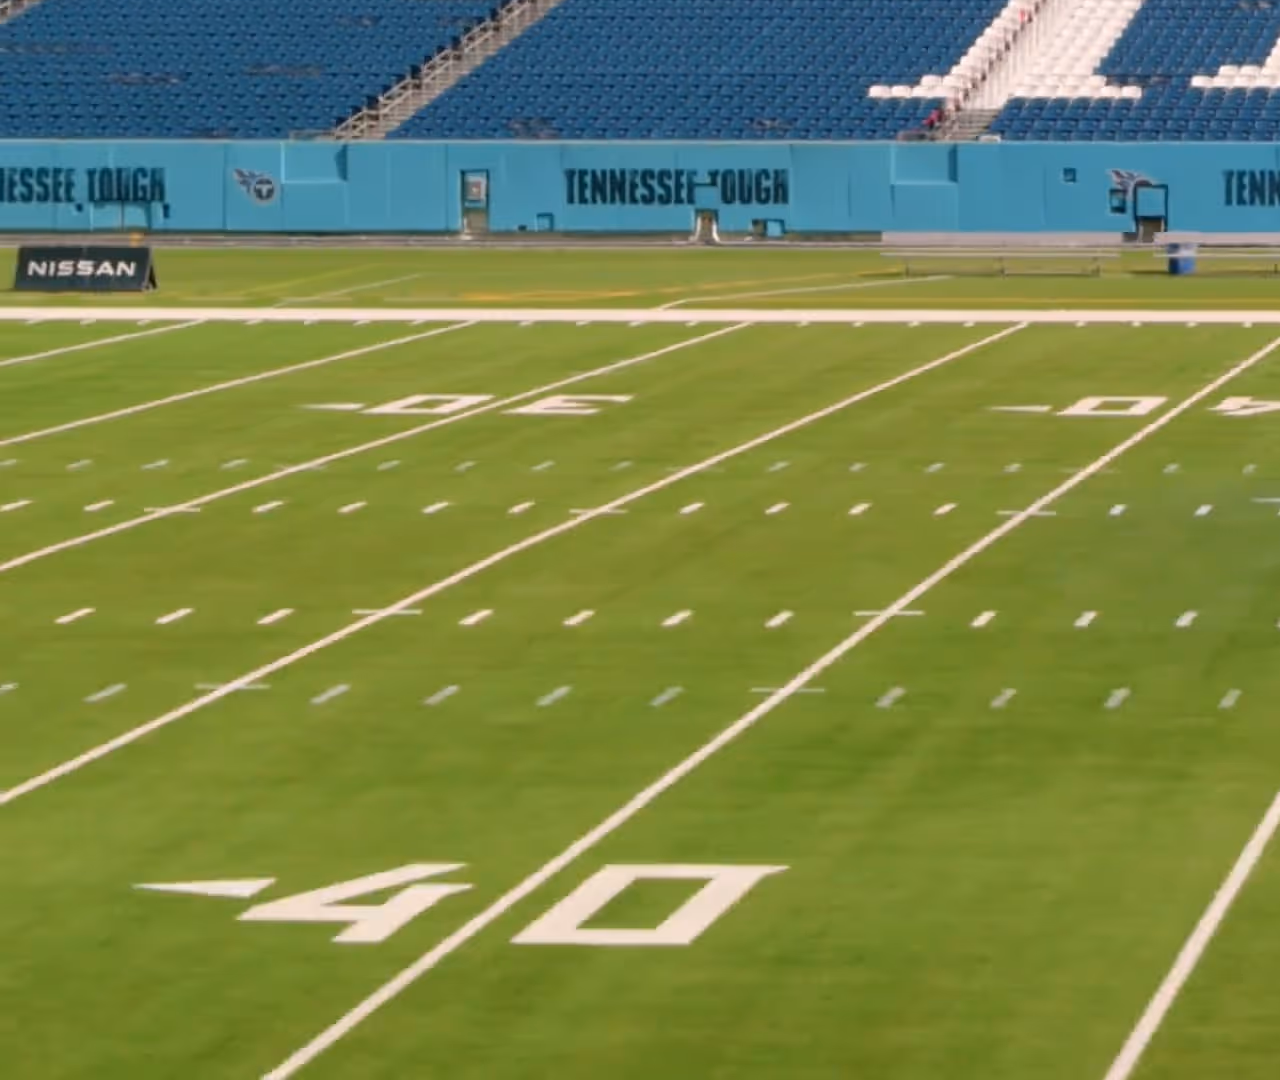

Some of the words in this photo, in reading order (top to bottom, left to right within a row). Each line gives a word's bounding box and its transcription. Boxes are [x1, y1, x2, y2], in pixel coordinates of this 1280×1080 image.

[0, 168, 75, 204] ESSEE
[87, 168, 165, 204] TOUGH
[565, 169, 697, 205] TENNESSEE
[27, 260, 137, 277] NISSAN
[236, 862, 792, 945] 40
